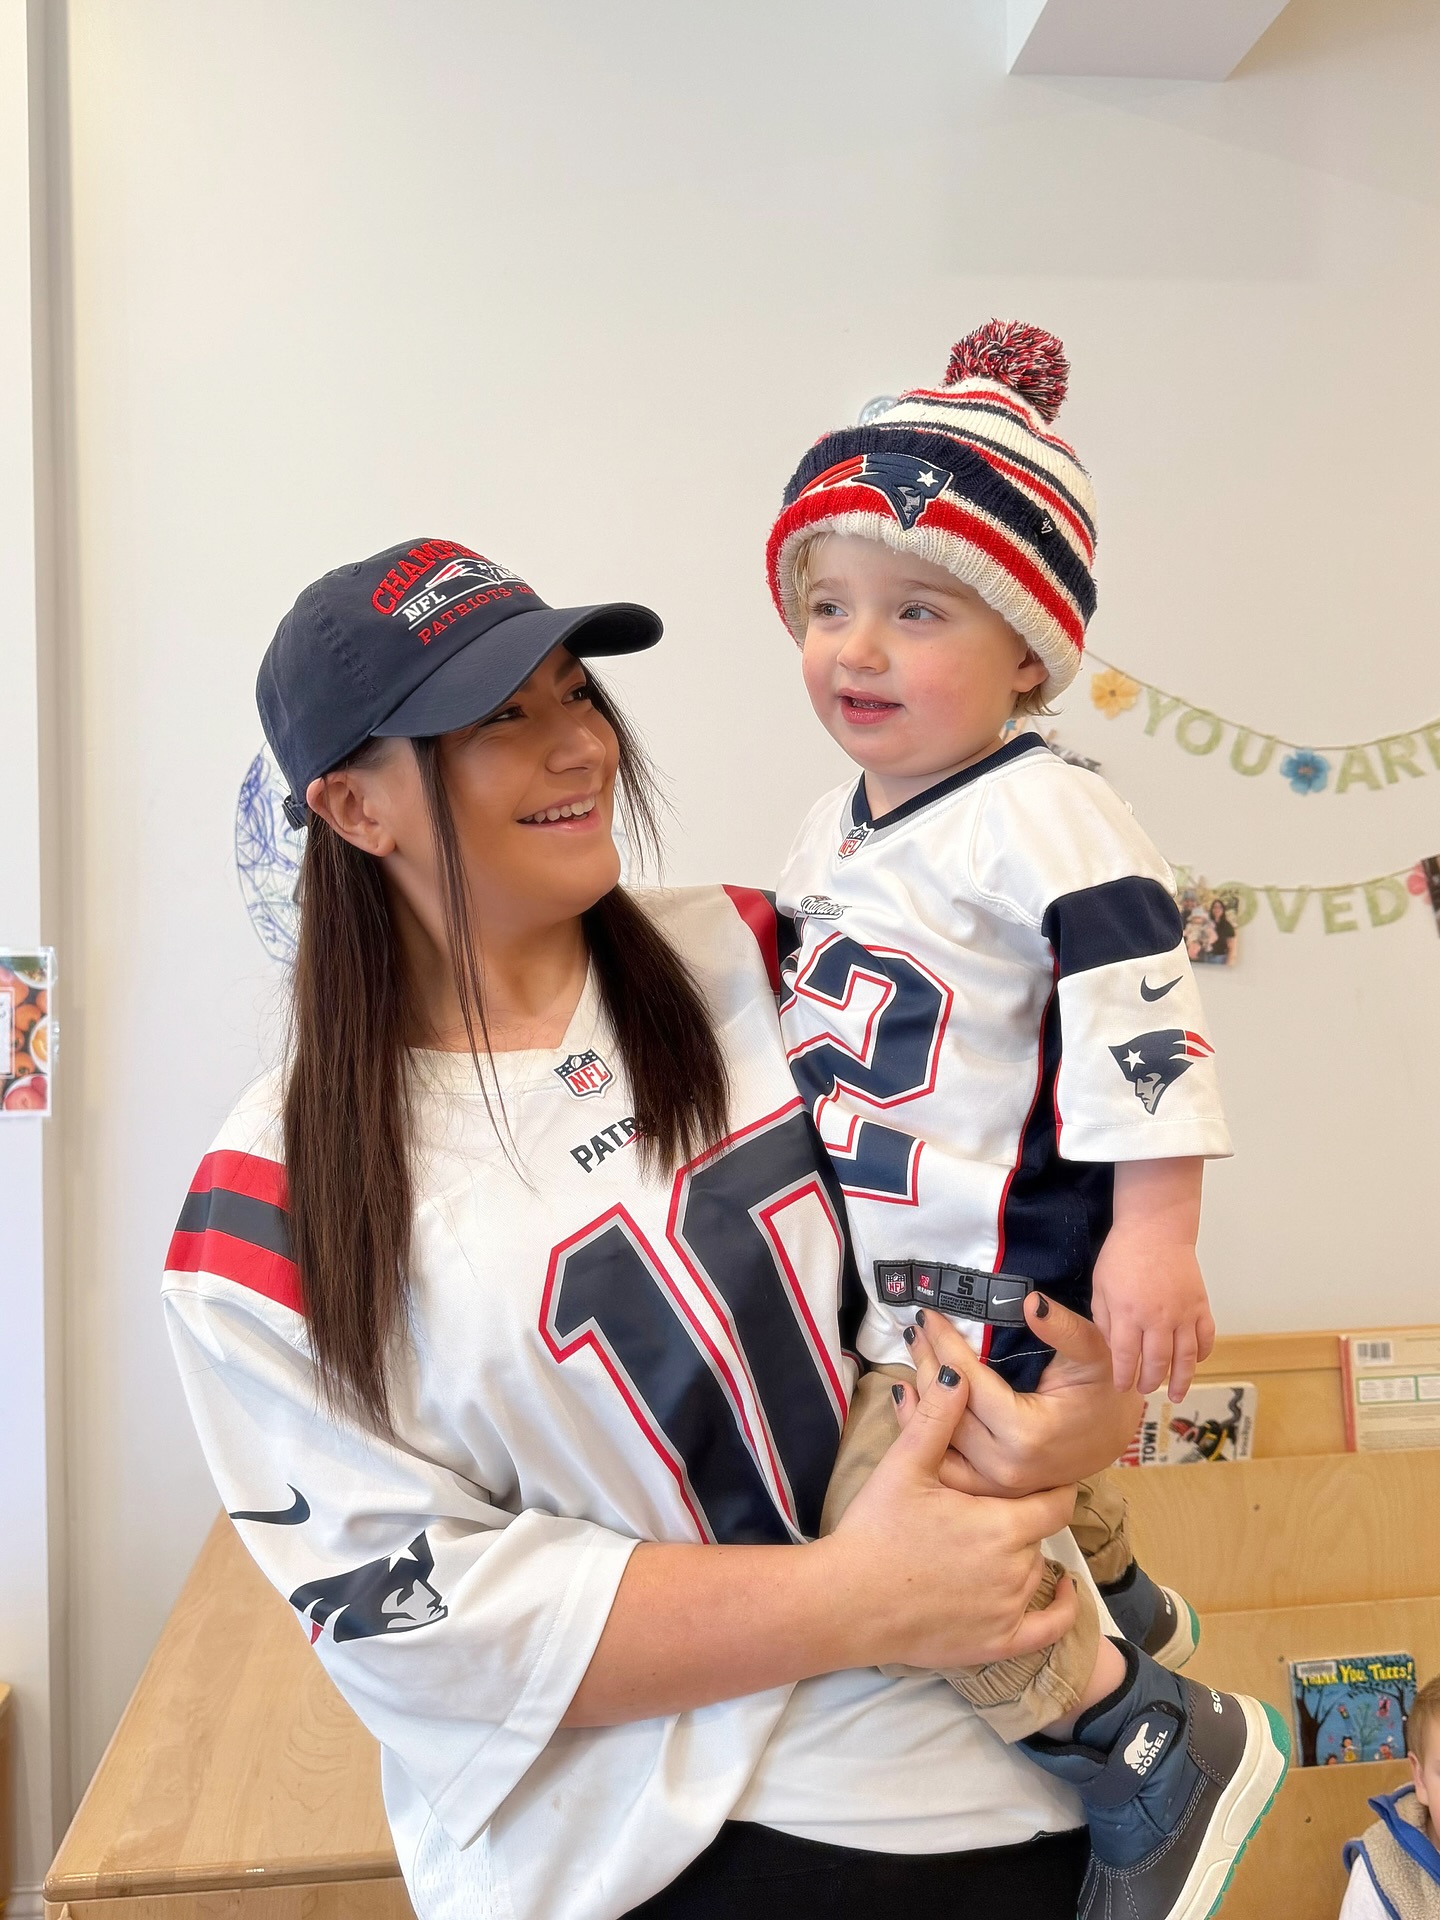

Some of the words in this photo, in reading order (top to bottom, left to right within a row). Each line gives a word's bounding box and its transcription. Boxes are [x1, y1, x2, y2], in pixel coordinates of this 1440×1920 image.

[372, 540, 488, 615] CHAMP
[402, 591, 446, 622] NFL
[418, 587, 512, 647] PATRIOTS
[1143, 687, 1277, 778] YOU
[840, 839, 858, 855] NFL
[568, 1062, 609, 1093] NFL
[570, 1116, 636, 1174] PATR
[888, 1281, 904, 1293] NFL
[958, 1275, 974, 1295] S
[538, 1096, 846, 1546] 10
[1141, 1421, 1158, 1463] TOWN
[1137, 1729, 1168, 1776] SOREL
